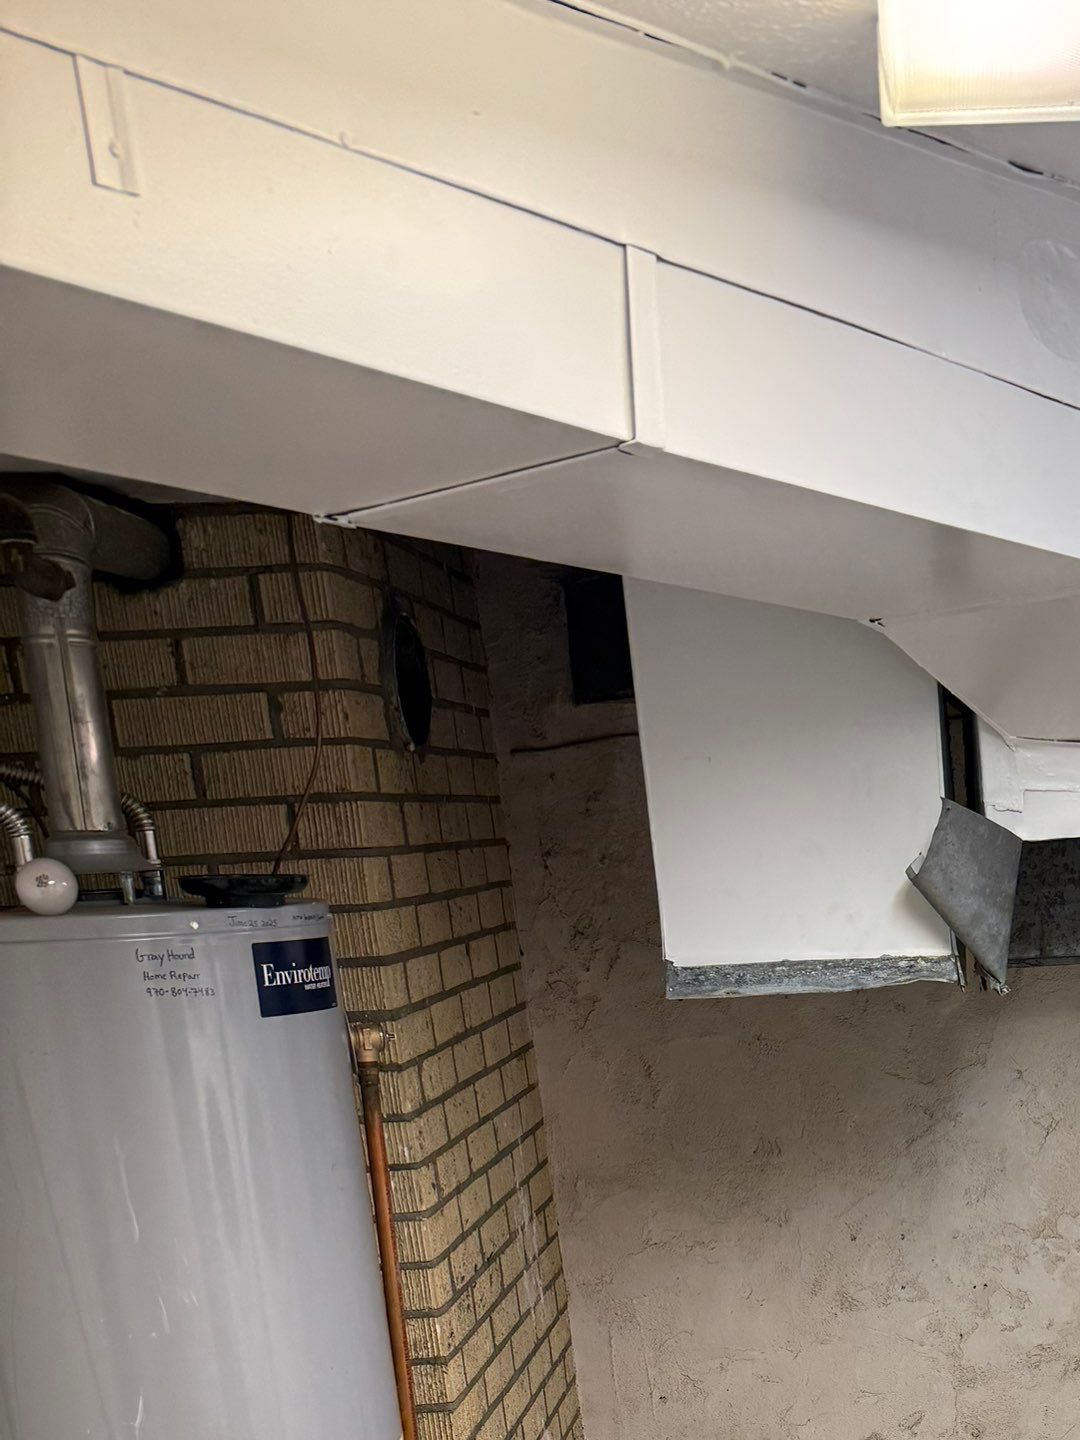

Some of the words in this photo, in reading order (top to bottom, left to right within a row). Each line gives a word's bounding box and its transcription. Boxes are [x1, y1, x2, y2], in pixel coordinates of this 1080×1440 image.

[135, 948, 165, 966] Gray
[166, 947, 196, 962] Hound
[143, 971, 167, 982] Home
[260, 962, 332, 987] Envirotemp
